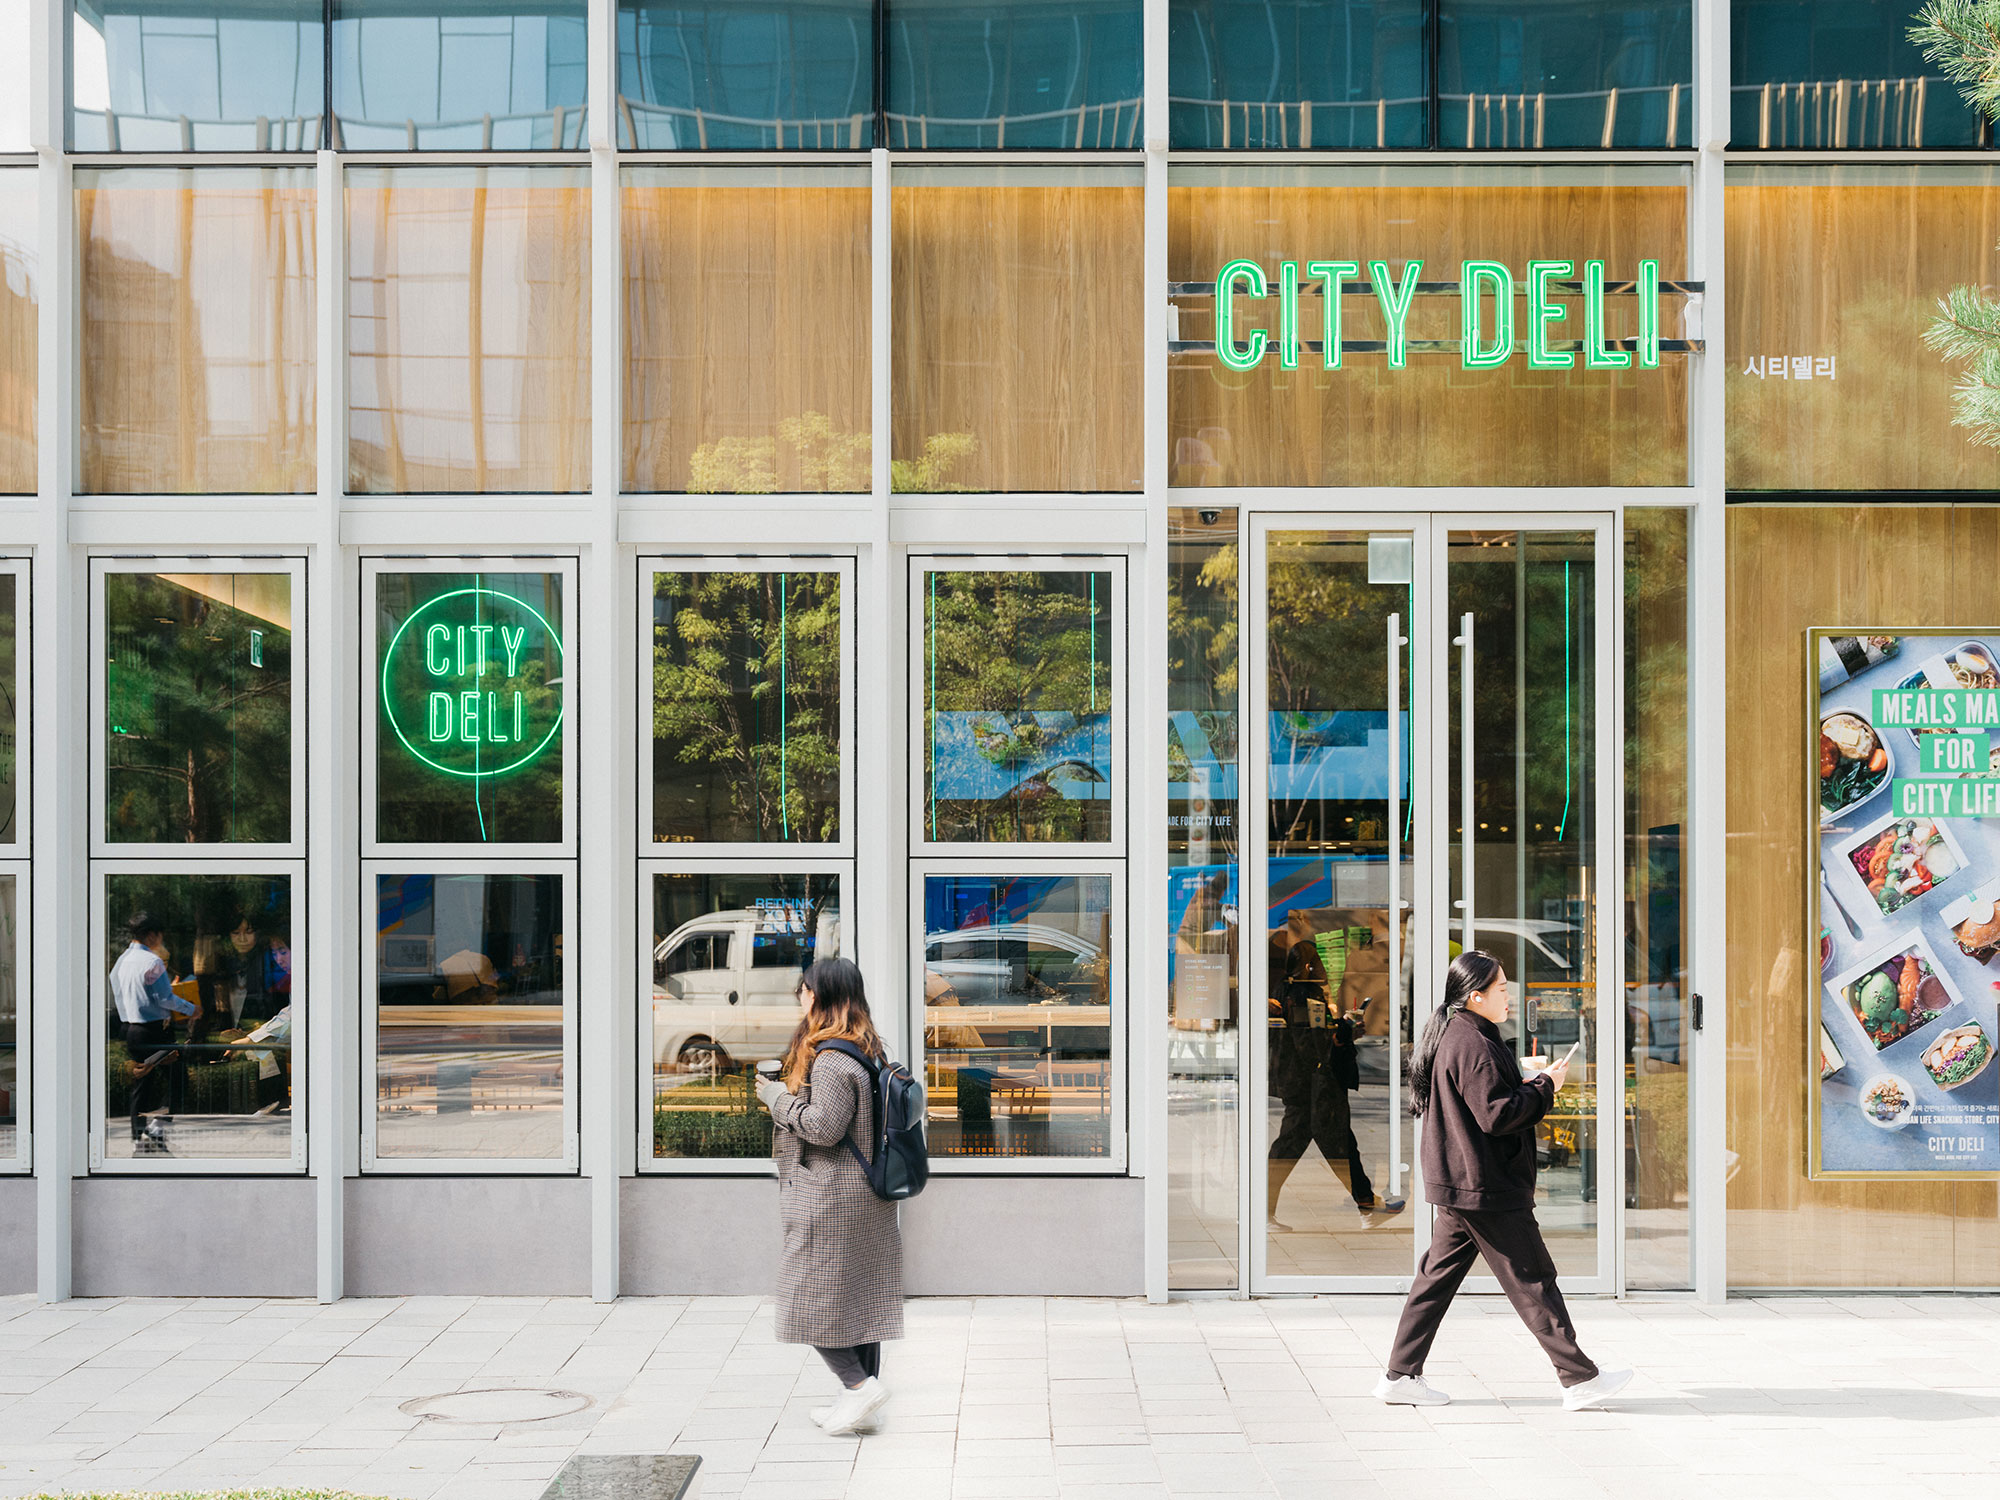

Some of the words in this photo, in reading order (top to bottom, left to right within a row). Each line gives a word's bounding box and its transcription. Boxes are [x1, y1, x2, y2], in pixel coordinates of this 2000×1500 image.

[1215, 258, 1425, 372] CITY
[1461, 259, 1660, 371] DELI
[1743, 355, 1836, 380] 시티델리
[426, 623, 525, 677] CITY
[429, 691, 522, 742] DELI
[1882, 693, 1957, 725] MEALS
[1933, 738, 1976, 769] FOR
[1902, 783, 1954, 815] CITY
[1180, 816, 1193, 826] FOR
[1195, 816, 1213, 826] CITY
[1215, 816, 1231, 826] LIFE
[755, 897, 815, 909] RETHINK
[1920, 1115, 1932, 1125] LIFE
[1928, 1137, 1956, 1152] CITY
[1959, 1137, 1984, 1152] DELI
